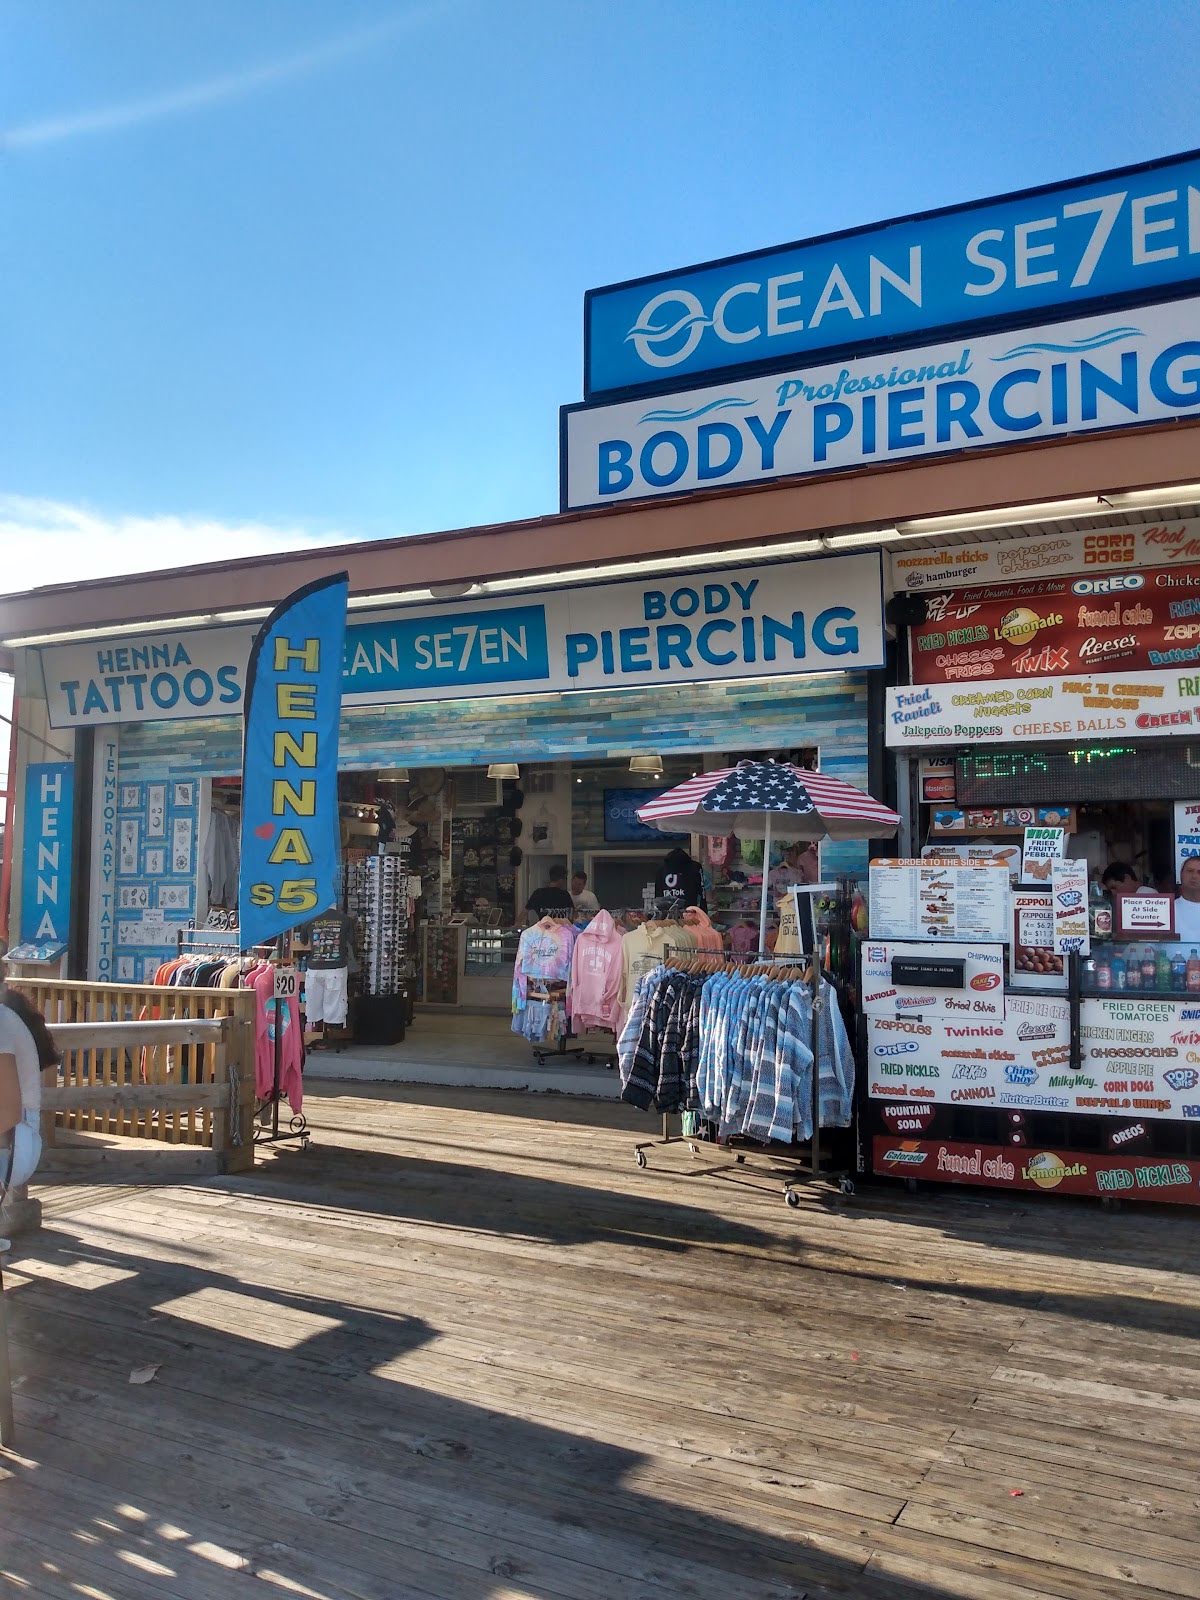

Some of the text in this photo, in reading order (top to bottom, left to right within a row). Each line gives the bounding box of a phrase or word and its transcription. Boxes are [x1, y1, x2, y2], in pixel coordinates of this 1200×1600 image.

[624, 245, 923, 368] OCEAN
[776, 349, 973, 407] Professional
[599, 341, 1200, 496] BODY PIERCING
[1143, 526, 1186, 545] Kool
[897, 551, 989, 568] mozzarella sticks
[996, 539, 1072, 565] popcorn
[1084, 549, 1134, 564] DOGS
[1000, 552, 1074, 575] chicken
[926, 566, 978, 582] hamburger
[963, 592, 982, 600] Fried
[1018, 584, 1036, 594] Food
[1046, 582, 1066, 592] More
[1072, 574, 1144, 597] OREO
[644, 579, 760, 621] BODY
[925, 593, 955, 611] RY
[925, 605, 982, 622] ME-UP
[1077, 601, 1154, 627] funnel cake
[994, 611, 1065, 640] Lemonade
[1163, 624, 1200, 640] ZEP
[566, 606, 860, 678] PIERCING
[917, 626, 990, 652] FRIED PICKLES
[1078, 634, 1137, 657] Reese's
[414, 625, 527, 672] SE7EN
[935, 647, 1005, 668] CHEESE
[1147, 643, 1200, 666] Butter
[97, 642, 192, 674] HENNA
[945, 661, 995, 679] FRIES
[60, 664, 242, 715] TATTOOS
[951, 686, 1054, 706] CREAMED CORN
[1061, 681, 1093, 695] MAC
[1108, 684, 1165, 697] CHEESE
[895, 688, 933, 709] Fried
[1083, 697, 1139, 710] WEDGES
[891, 702, 943, 725] Ravioli
[973, 703, 1032, 718] NUGGETS
[1135, 709, 1192, 730] GREEN
[953, 723, 1003, 738] Poppers
[1013, 717, 1127, 736] CHEESE BALLS
[268, 636, 321, 866] HENNA
[928, 758, 954, 767] VISA
[102, 743, 116, 883] TEMPORARY
[1026, 829, 1063, 840] WHOA!
[36, 773, 62, 939] HENNA
[898, 858, 981, 866] ORDER TO THE SIDE
[250, 878, 319, 914] $5
[663, 889, 685, 897] TikTok
[1060, 937, 1081, 946] Chips
[967, 952, 1001, 963] CHIPWICH
[276, 975, 295, 994] $20
[972, 975, 996, 987] TAKE 5
[865, 988, 897, 1002] RAVIOLIS
[944, 997, 971, 1011] Fried
[973, 1000, 996, 1013] Elvis
[1010, 1000, 1071, 1020] FRIED ICE CREA
[1102, 1002, 1176, 1013] FRIED GREEN
[1109, 1011, 1169, 1022] TOMATOES
[944, 1026, 1004, 1037] Twinkie
[1017, 1022, 1057, 1036] Reese's
[1080, 1025, 1155, 1043] HICKEN FINGERS
[874, 1041, 919, 1056] OREO
[1031, 1043, 1084, 1060] popco
[1036, 1052, 1087, 1068] chick
[1106, 1061, 1154, 1076] APPLE PIE
[880, 1063, 940, 1078] FRIED PICKLES
[1004, 1065, 1035, 1076] Chips
[872, 1083, 935, 1098] funnel cake
[951, 1086, 996, 1101] CANNOLI
[1104, 1081, 1154, 1092] CORN DOGS
[1000, 1092, 1069, 1107] Nutter Butter
[885, 1105, 931, 1117] FOUNTAIN
[897, 1119, 923, 1130] SODA
[1112, 1123, 1145, 1145] OREOS
[886, 1151, 924, 1162] Gatorade
[937, 1147, 1015, 1180] funnel cake
[1021, 1162, 1088, 1180] Lemonade
[1095, 1163, 1192, 1191] FRIED PICKLES
